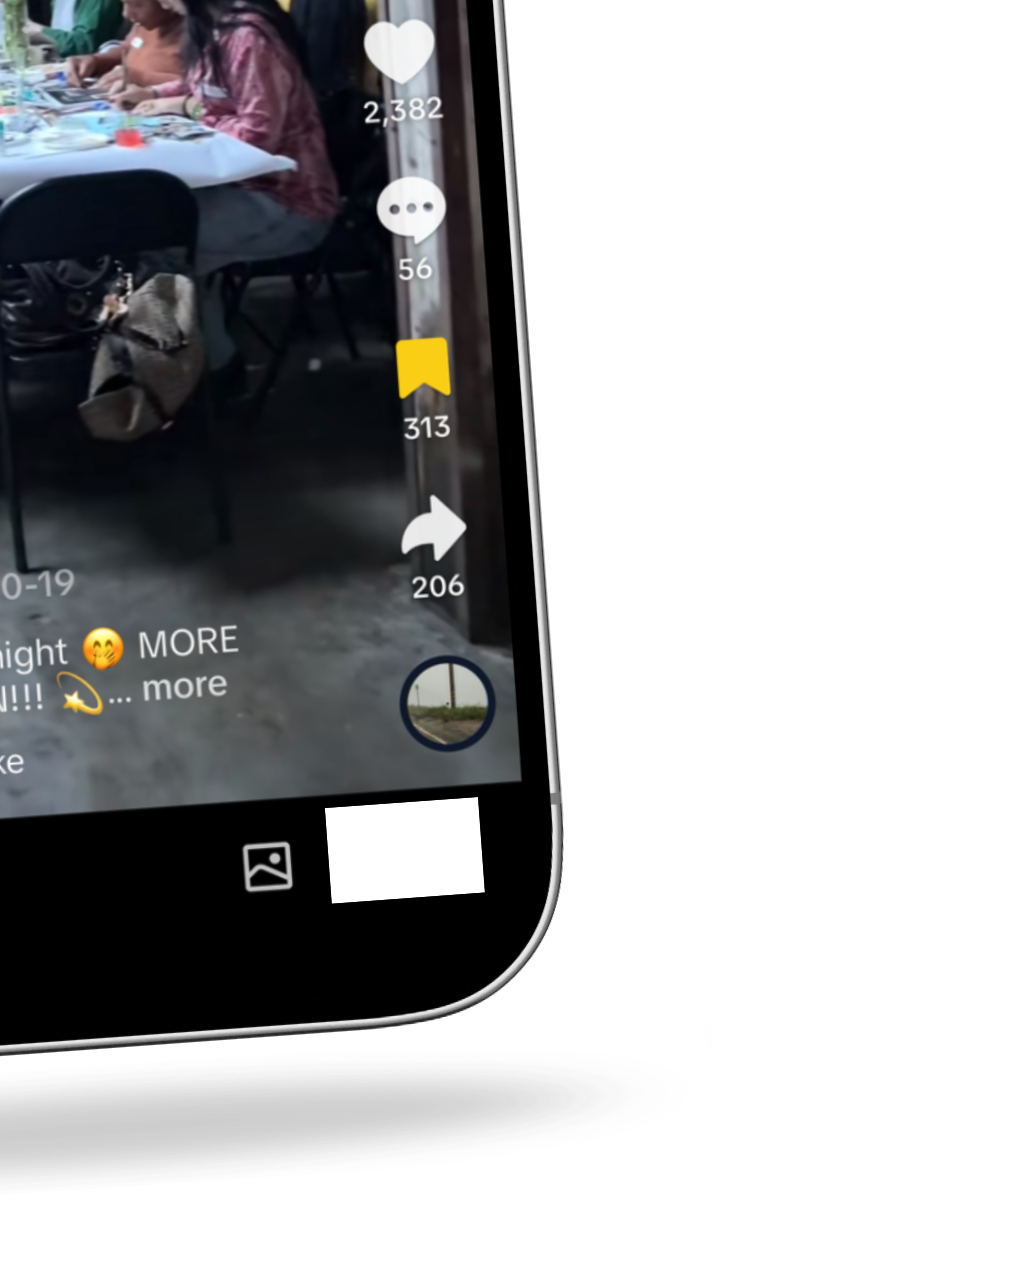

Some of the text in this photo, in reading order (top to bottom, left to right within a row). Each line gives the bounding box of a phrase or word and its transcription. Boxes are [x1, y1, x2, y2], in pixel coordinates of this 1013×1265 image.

[363, 96, 444, 128] 2,382
[398, 256, 433, 281] 56
[403, 415, 451, 440] 313
[412, 573, 465, 599] 206
[138, 625, 240, 659] MORE
[142, 674, 228, 702] more
